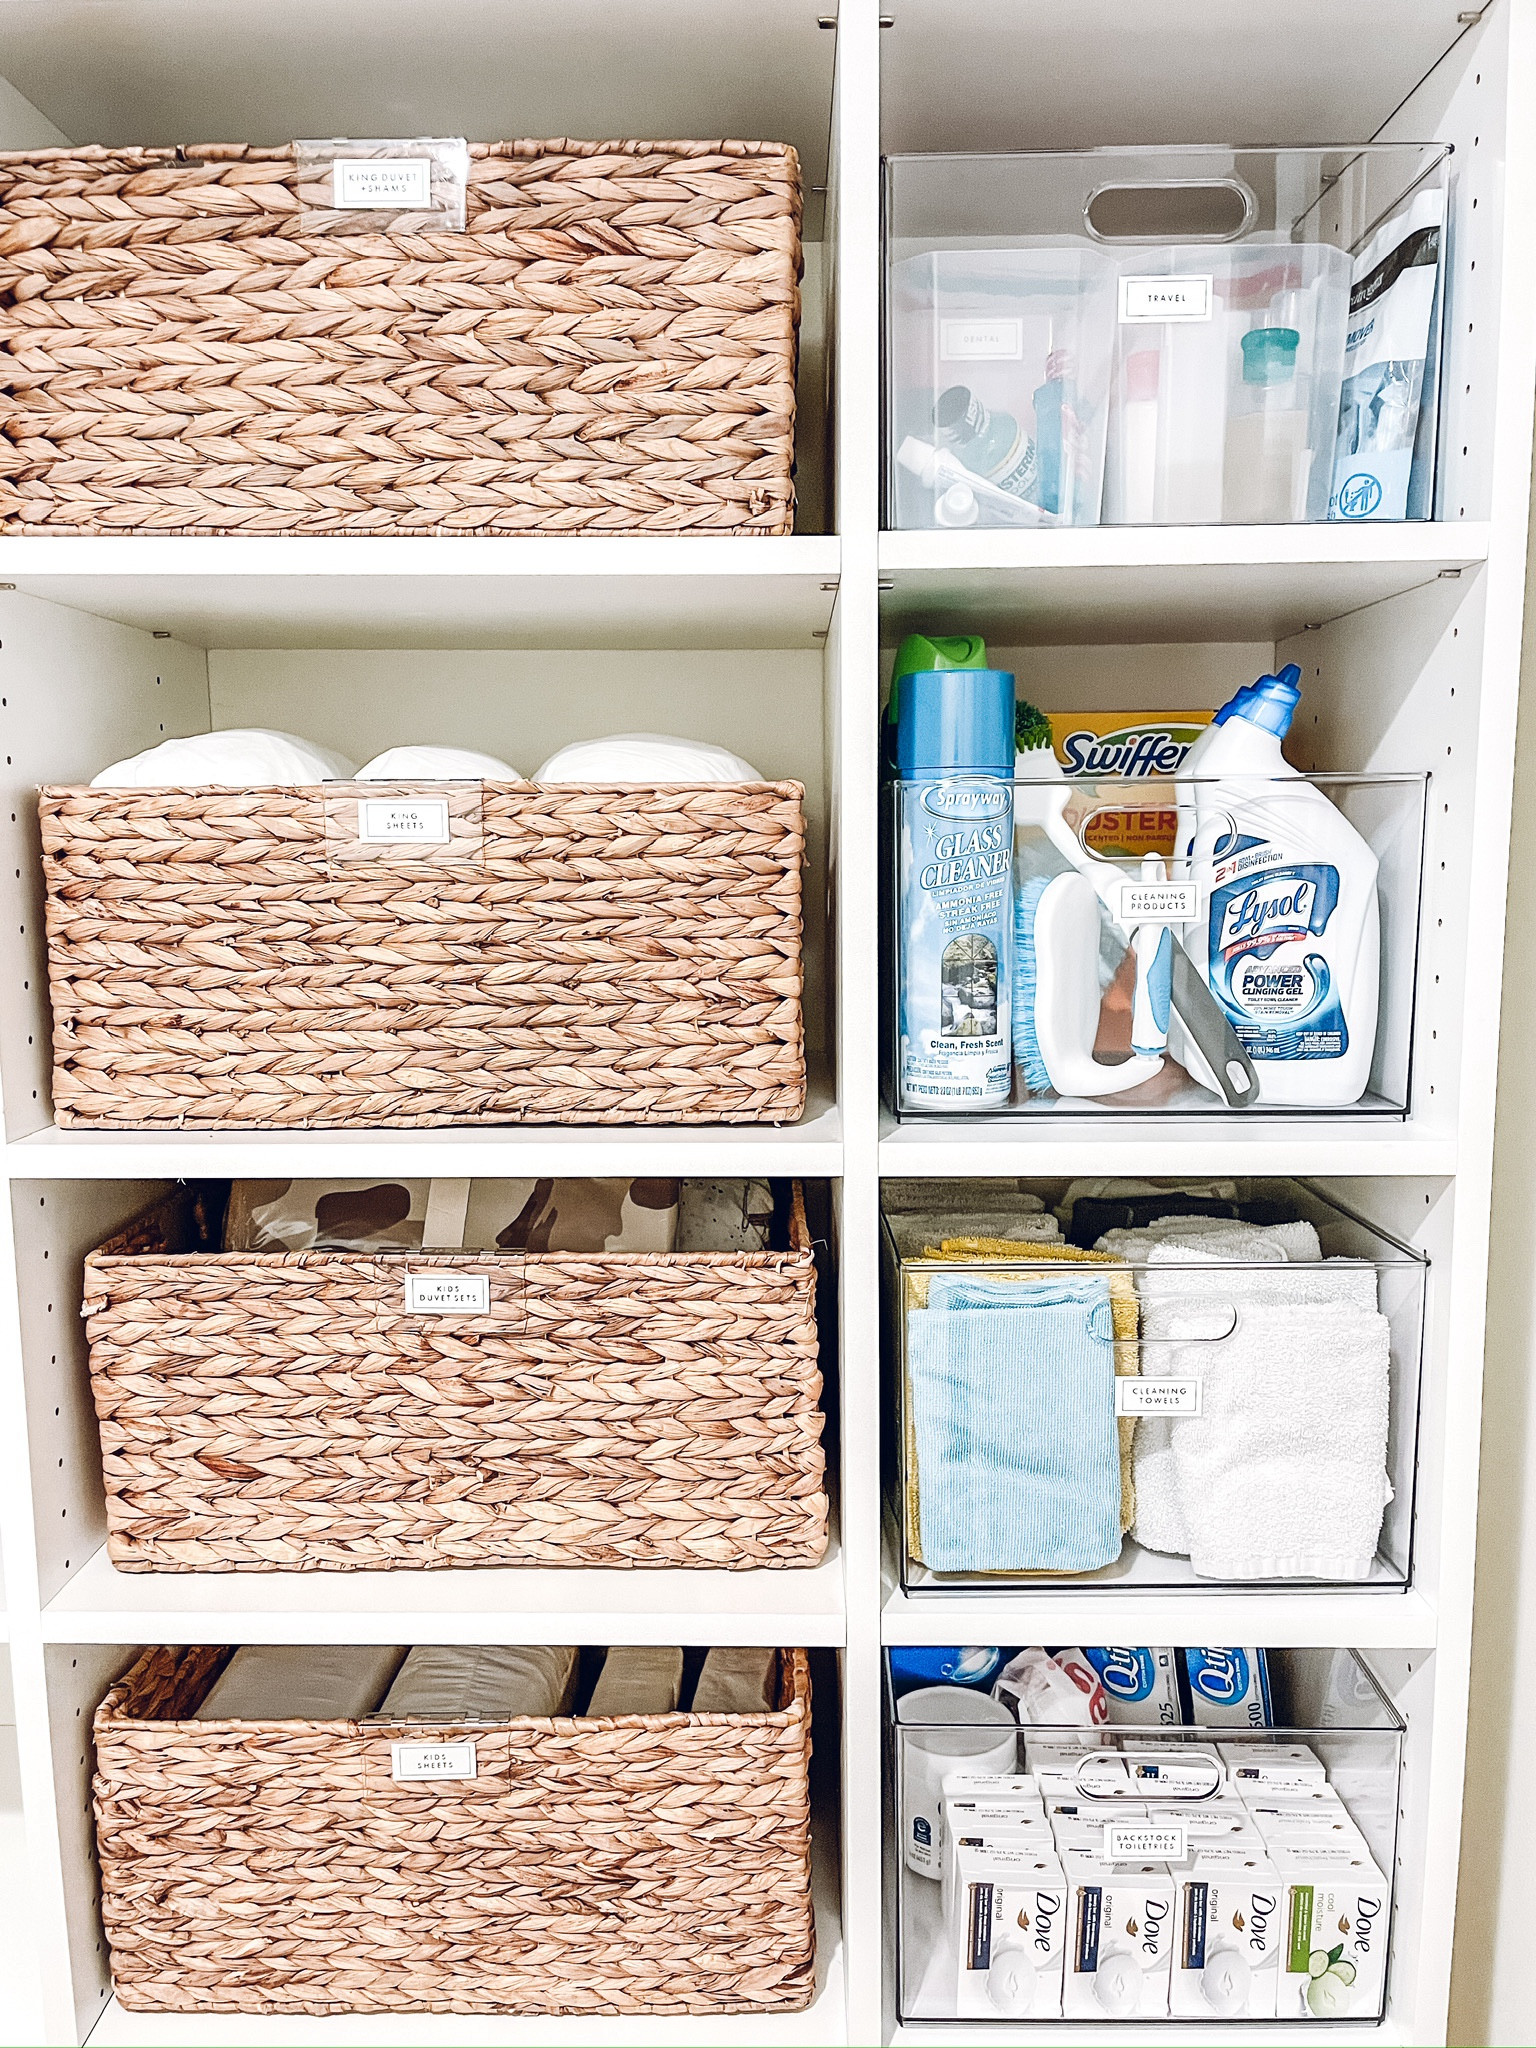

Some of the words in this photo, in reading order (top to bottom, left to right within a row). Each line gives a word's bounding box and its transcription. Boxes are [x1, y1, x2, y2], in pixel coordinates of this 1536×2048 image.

[349, 173, 378, 182] KING
[381, 173, 418, 182] DUVET
[1147, 294, 1187, 302] TRAVEL
[963, 335, 1000, 343] DENTAL
[1060, 733, 1193, 777] Swiffer
[936, 790, 1006, 811] Sprayway
[391, 812, 418, 820] KING
[386, 822, 425, 830] SHEETS
[935, 824, 1002, 861] GLASS
[920, 848, 1010, 890] CLEANER
[1237, 853, 1283, 872] DISINFECTION
[932, 885, 974, 897] LIMPIADOR
[975, 881, 985, 889] DE
[1131, 893, 1186, 901] CLEANING
[936, 895, 982, 910] AMMONIA
[984, 889, 1003, 901] FREE
[1131, 902, 1186, 910] PRODUCTS
[939, 905, 978, 919] STREAK
[981, 899, 1001, 911] FREE
[1228, 882, 1308, 936] Lysol
[1244, 965, 1302, 974] ADVANCED
[1242, 974, 1304, 988] POWER
[930, 1040, 958, 1050] Clean,
[960, 1039, 984, 1049] Fresh
[985, 1038, 1004, 1048] Scent
[436, 1285, 460, 1293] KIDS
[419, 1294, 451, 1302] DUVET
[454, 1294, 477, 1302] SETS
[1132, 1387, 1187, 1395] CLEANING
[1139, 1397, 1180, 1405] TOWELS
[417, 1761, 454, 1769] SHEETS
[423, 1753, 447, 1761] KIDS
[1116, 1834, 1177, 1842] BACKSTOCK
[994, 1888, 1004, 1921] original
[1209, 1889, 1219, 1922] original
[1327, 1892, 1335, 1913] cool
[1103, 1894, 1113, 1929] original
[1314, 1893, 1324, 1932] moisture
[1034, 1892, 1061, 1952] Dove
[1142, 1899, 1169, 1955] Dove
[1249, 1893, 1277, 1951] Dove
[1354, 1896, 1382, 1952] Dove
